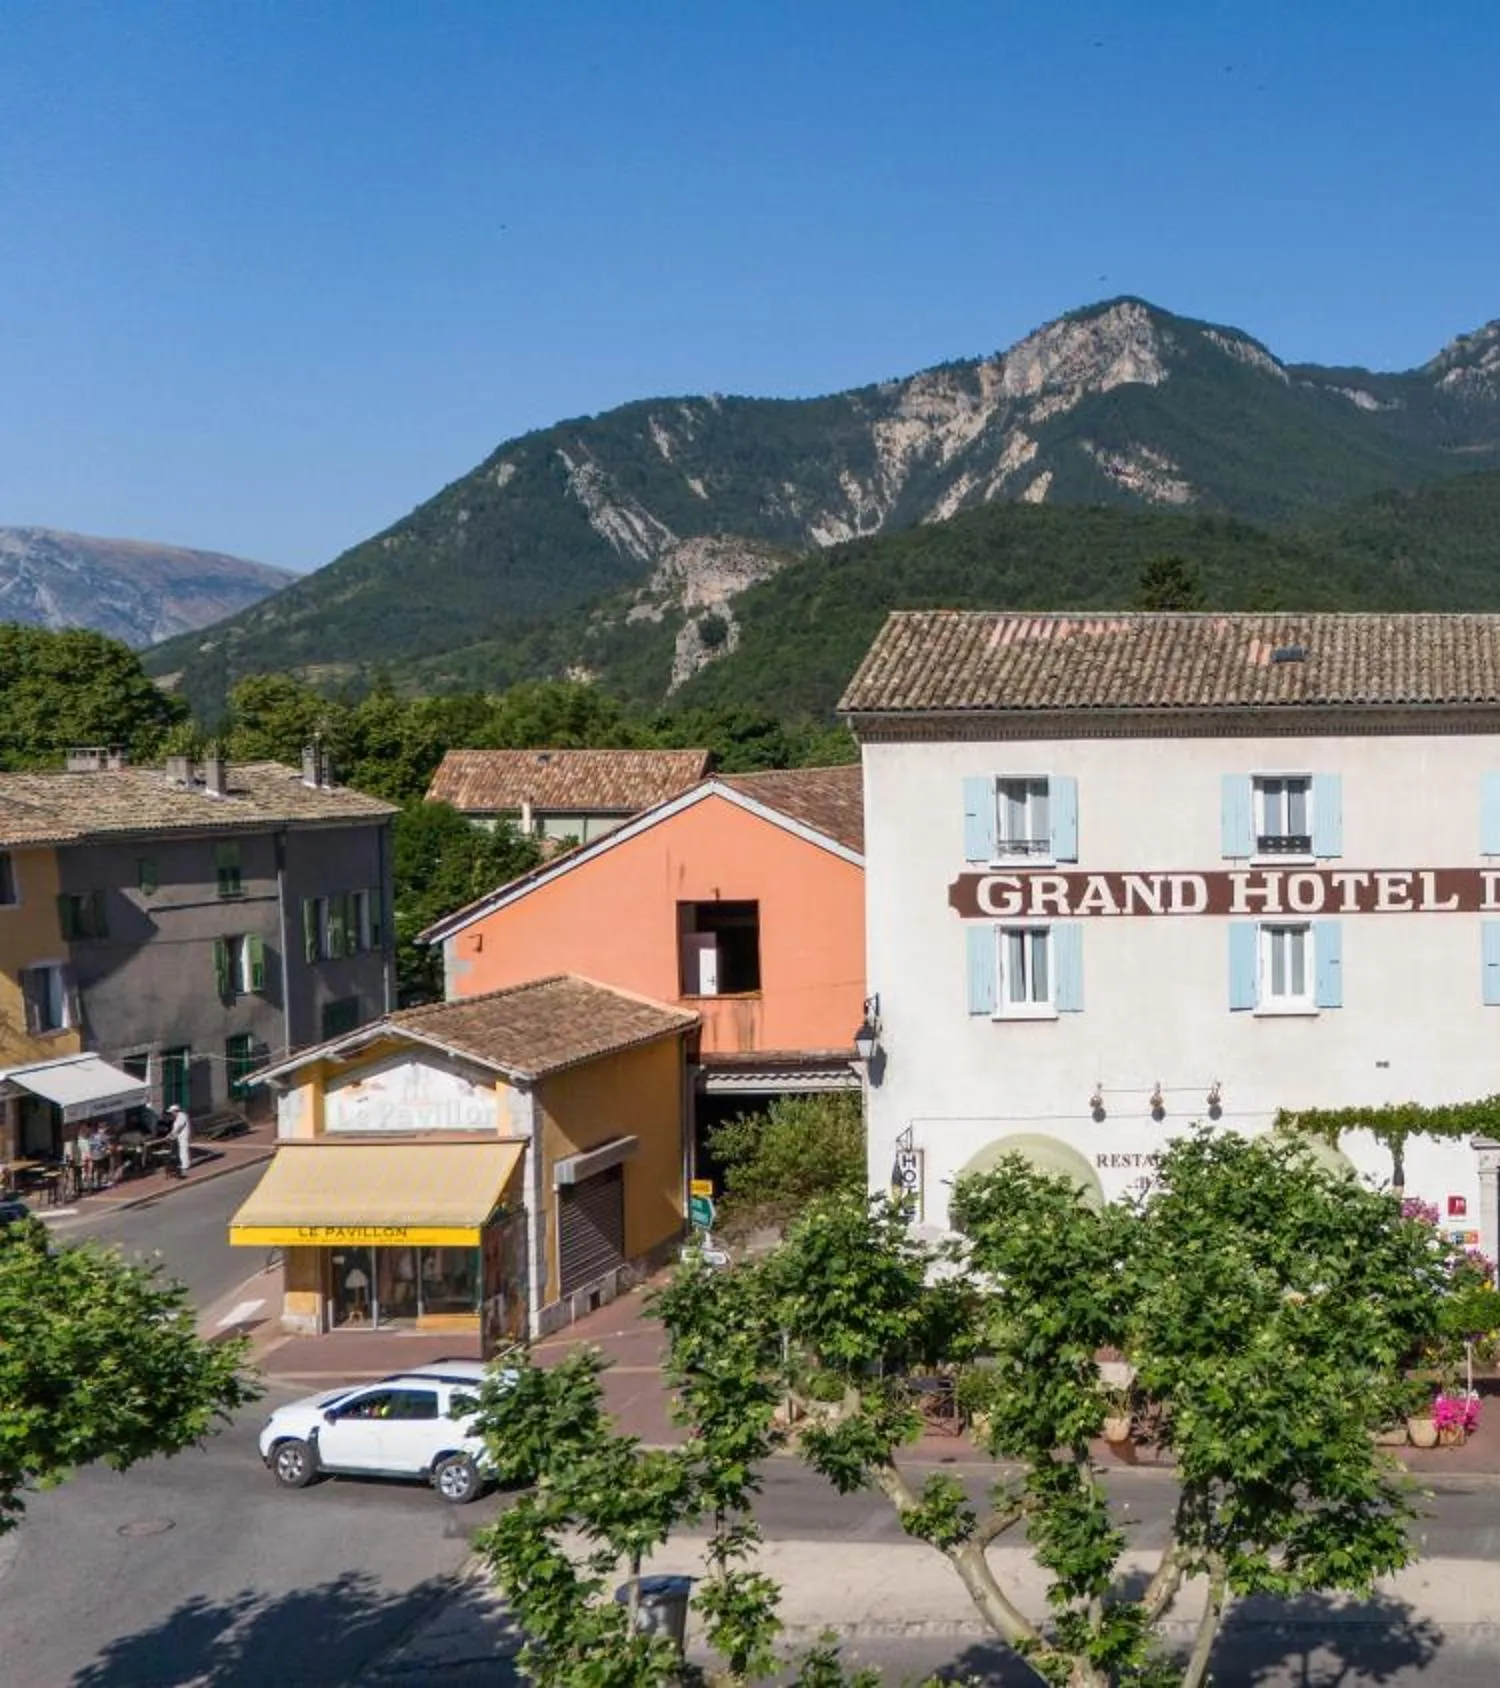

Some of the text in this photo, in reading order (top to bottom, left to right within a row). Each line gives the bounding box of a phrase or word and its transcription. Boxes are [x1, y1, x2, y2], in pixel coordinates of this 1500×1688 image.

[976, 874, 1208, 916] GRAND
[1228, 871, 1460, 914] HOTEL
[297, 1226, 409, 1238] LE PAVILLON
